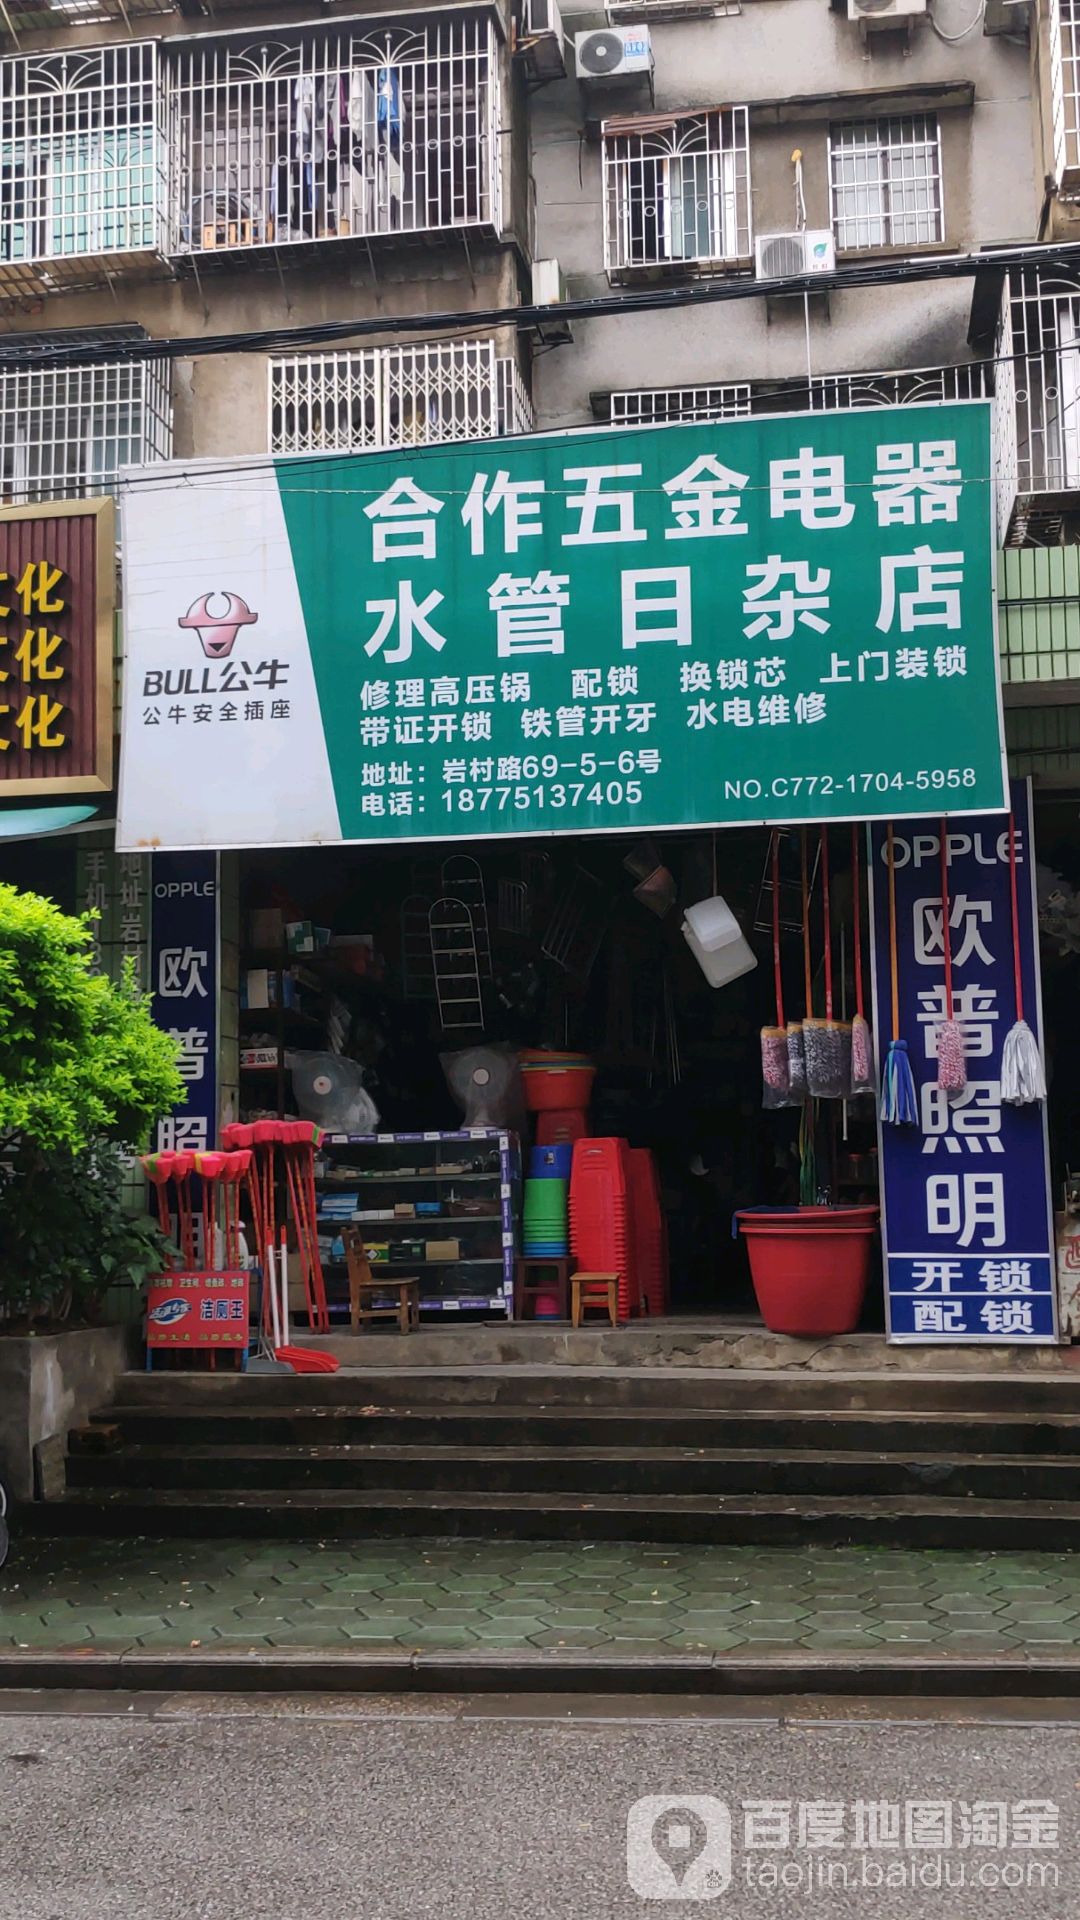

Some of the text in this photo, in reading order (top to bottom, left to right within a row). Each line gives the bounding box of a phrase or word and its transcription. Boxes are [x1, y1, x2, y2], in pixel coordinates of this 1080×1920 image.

[362, 440, 964, 563] 合作五金电器
[0, 561, 65, 618] 化
[363, 544, 966, 665] 水管日杂店
[0, 627, 65, 683] 化
[142, 658, 290, 698] BULL公牛
[359, 645, 968, 711] 修理高压锅 配锁 换锁芯 上门装锁
[0, 694, 65, 750] 化
[142, 698, 291, 726] 公牛安全插座
[359, 691, 828, 748] 带证开锁 铁管开牙 水电维修
[724, 768, 977, 800] NO.C772-1704-5958
[880, 830, 1024, 869] OPPLE
[154, 881, 215, 898] OPPLE
[912, 894, 1006, 1248] 欧普照明
[911, 1260, 1034, 1293] 开锁
[912, 1300, 1035, 1334] 配锁
